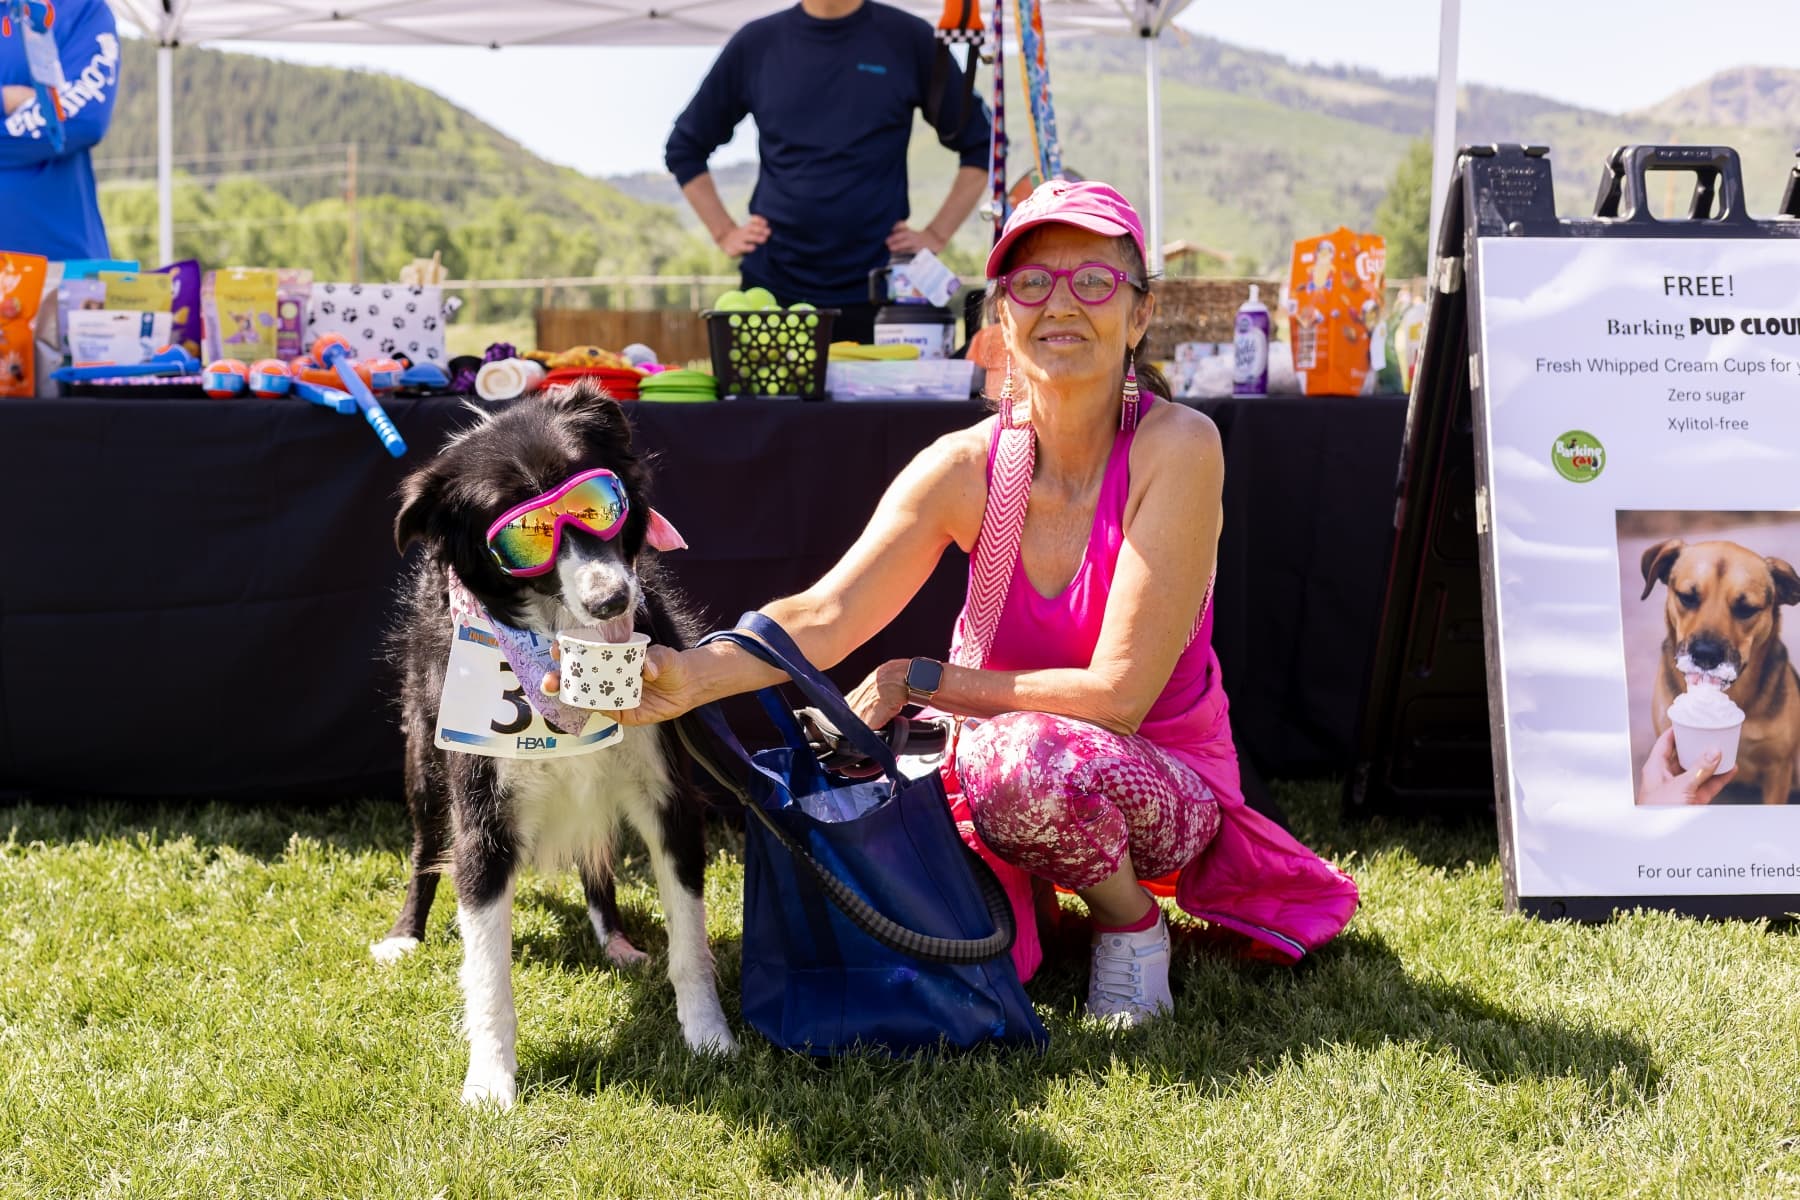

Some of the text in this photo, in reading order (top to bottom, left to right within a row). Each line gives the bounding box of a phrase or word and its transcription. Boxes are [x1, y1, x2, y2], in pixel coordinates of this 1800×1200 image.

[1663, 274, 1734, 297] FREE!
[1607, 319, 1685, 341] Barking
[1689, 316, 1735, 336] PUP
[1536, 358, 1582, 373] Fresh
[1586, 358, 1659, 376] Whipped
[1664, 358, 1719, 373] Cream
[1723, 358, 1766, 376] Cups
[1770, 358, 1792, 373] for
[1667, 388, 1746, 405] Zero sugar
[1667, 416, 1750, 432] Xylitol-free
[516, 736, 546, 750] HBA
[1637, 863, 1800, 879] For our canine friends
